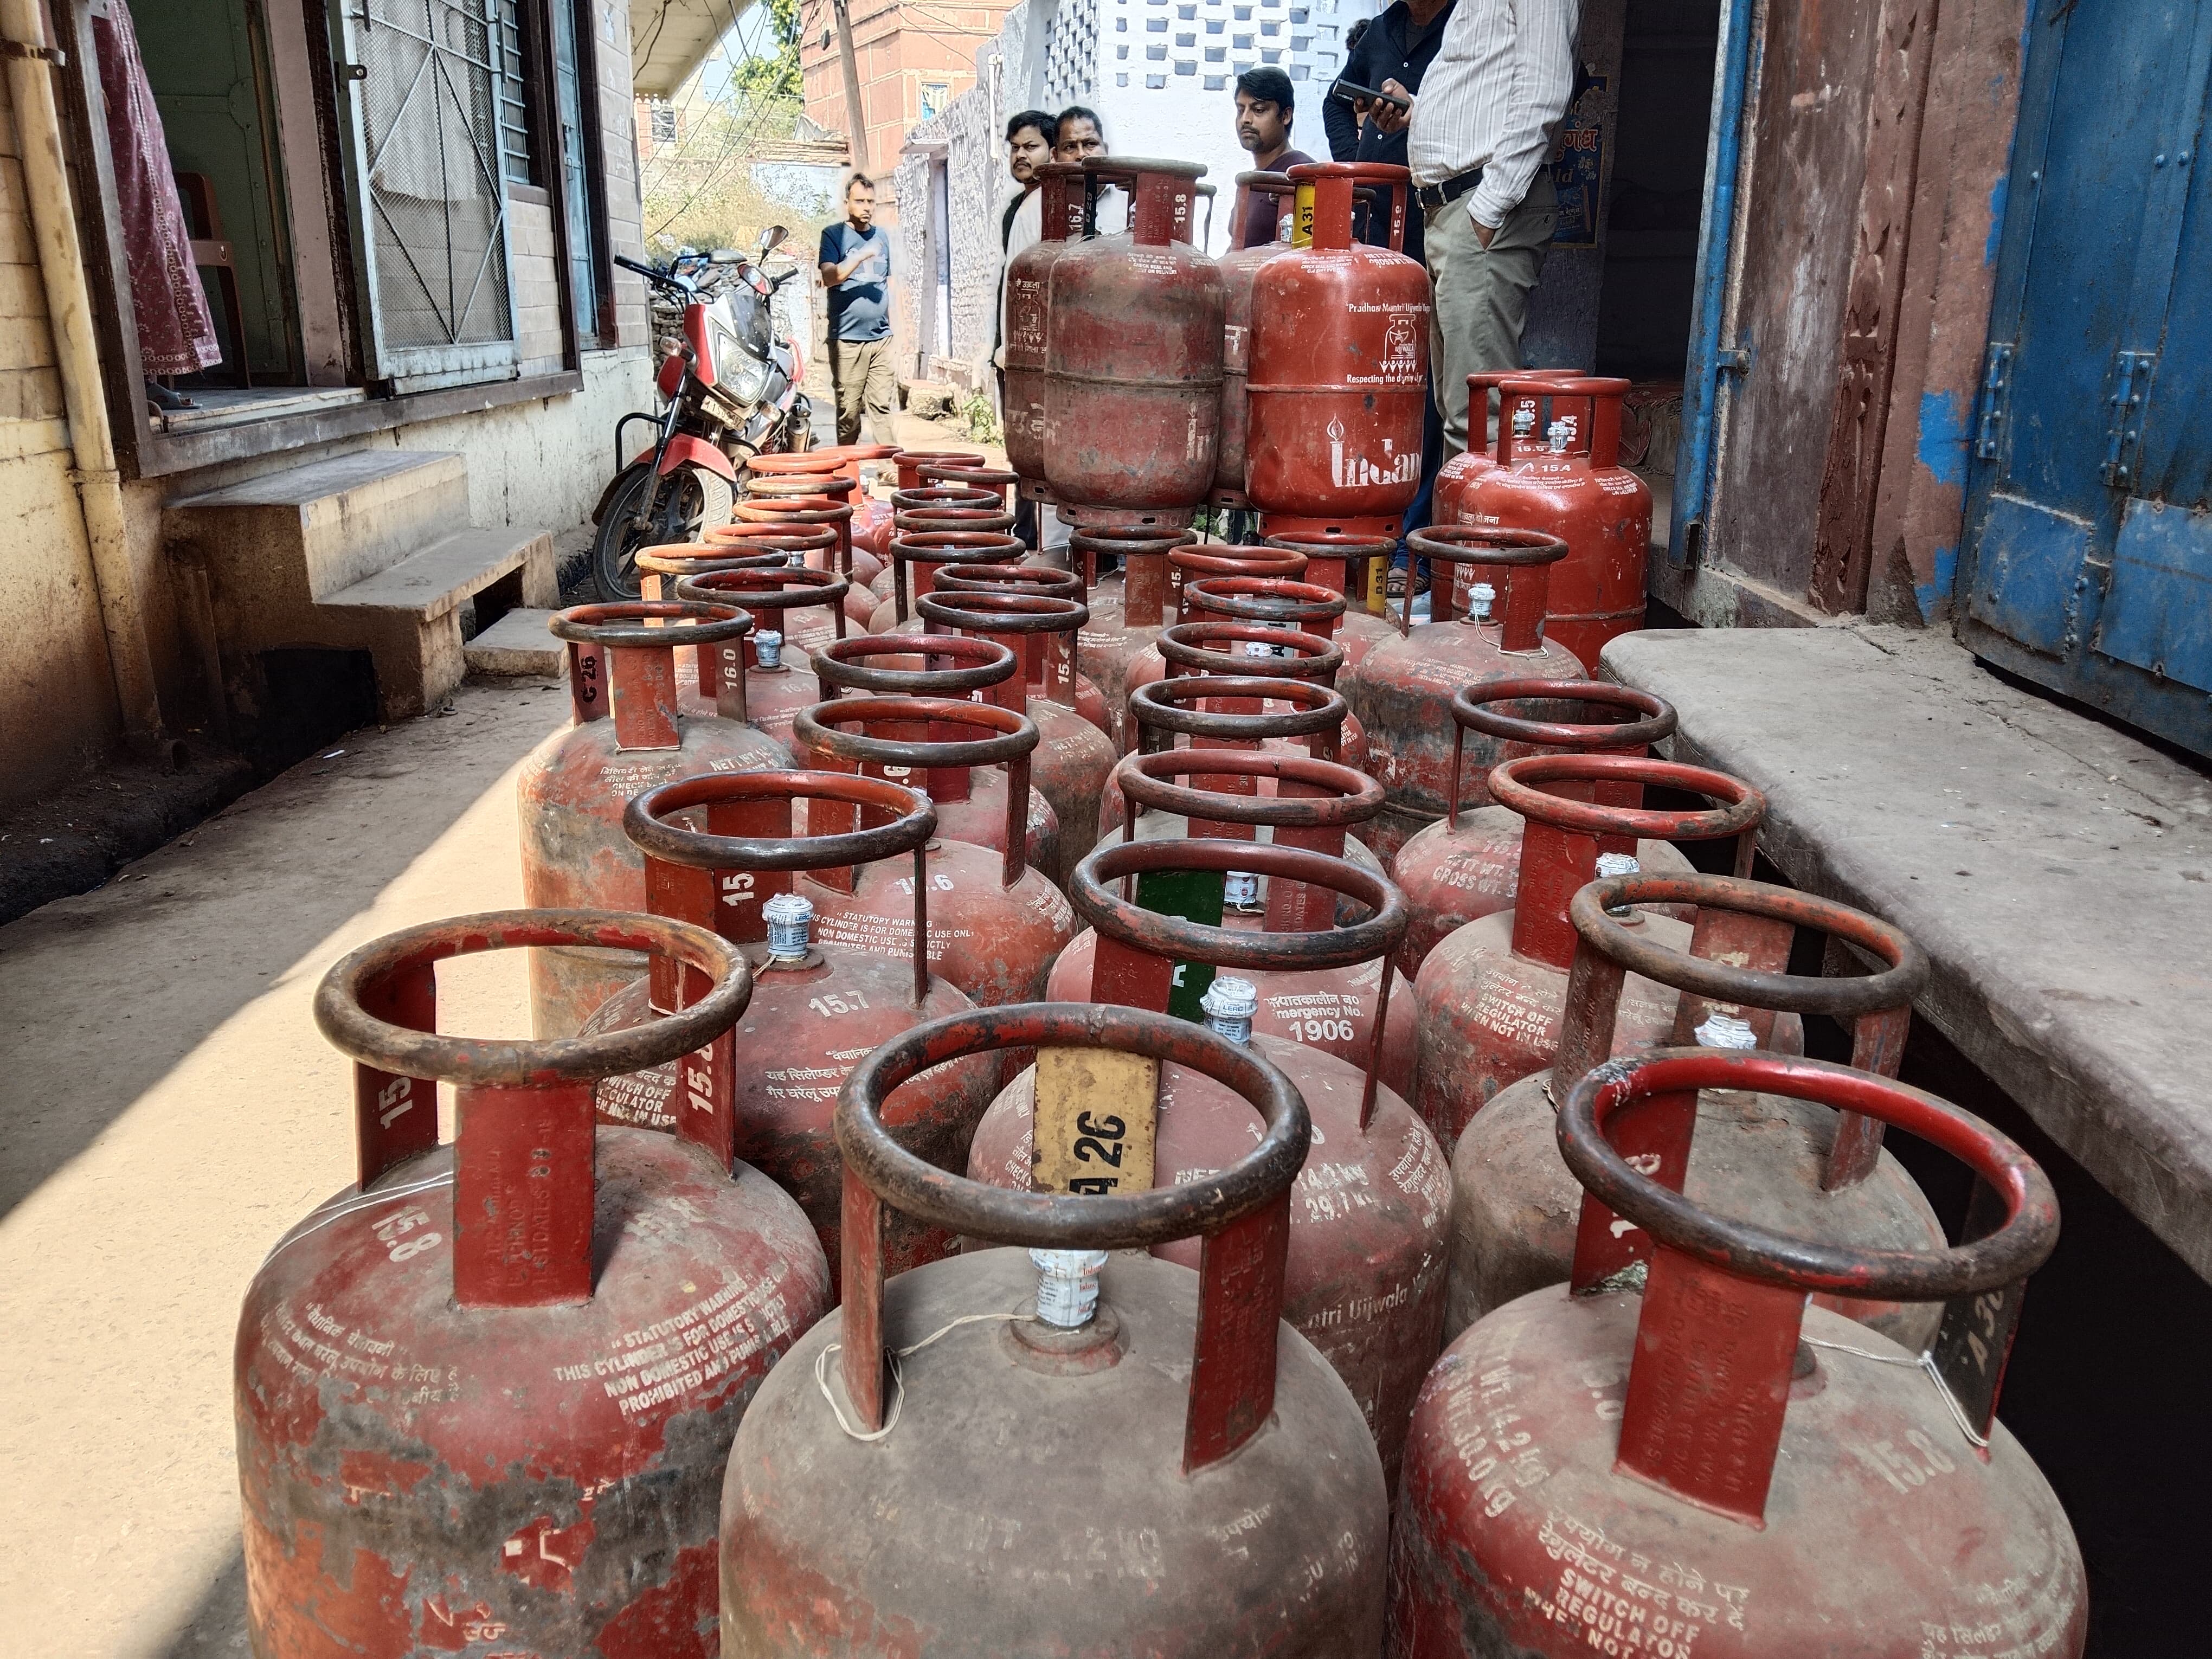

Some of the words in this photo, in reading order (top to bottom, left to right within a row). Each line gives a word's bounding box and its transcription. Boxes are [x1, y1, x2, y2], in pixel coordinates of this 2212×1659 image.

[1174, 194, 1186, 223] 15.8
[1302, 207, 1313, 222] 31
[1302, 226, 1313, 235] A
[1347, 374, 1384, 384] Respecting
[1385, 374, 1396, 382] the
[1375, 568, 1383, 582] 31
[1375, 584, 1383, 595] D
[582, 655, 597, 681] 26
[724, 648, 738, 690] 16.0
[582, 686, 597, 703] C
[781, 683, 813, 693] 16.1
[1433, 866, 1476, 890] GROSS
[821, 916, 858, 930] CYLINDER
[870, 925, 886, 935] FOR
[935, 930, 951, 938] USE
[843, 912, 890, 926] STATUTORY
[892, 919, 933, 927] WARNG
[818, 927, 834, 938] NON
[837, 931, 878, 944] DOMESTIC
[880, 937, 896, 946] USE
[808, 989, 870, 1018] 15.7
[1271, 1006, 1340, 1019] mergency
[1343, 1006, 1364, 1017] No.
[1482, 993, 1526, 1018] SWITCH
[1527, 1012, 1553, 1026] OFF
[1289, 1019, 1354, 1042] 1906
[1475, 1001, 1546, 1036] REGULATOR
[1489, 1020, 1515, 1037] NOT
[765, 1070, 786, 1081] यह
[596, 1096, 608, 1111] EN
[645, 1086, 672, 1099] OFF
[766, 1085, 786, 1099] गैर
[786, 1084, 823, 1103] घरेलू
[1073, 1110, 1126, 1169] 26
[1005, 1160, 1030, 1185] CHECK
[371, 1205, 443, 1263] 15.8
[622, 1307, 700, 1348] STATUTORY
[698, 1278, 748, 1315] WARNING
[1307, 1304, 1342, 1328] ntri
[1348, 1284, 1409, 1321] Ujjwala
[553, 1362, 592, 1382] THIS
[594, 1343, 668, 1376] CYLINDER
[683, 1326, 709, 1348] FOR
[603, 1374, 639, 1398] NON
[639, 1344, 709, 1387] DOMESTIC
[710, 1335, 731, 1354] USE
[618, 1371, 703, 1416] PROHIBITED
[1848, 1428, 1957, 1495] 15.8
[1538, 1517, 1617, 1584] रेगुलेटर
[1630, 1553, 1651, 1573] न
[1560, 1568, 1647, 1623] SWITCH
[1652, 1616, 1701, 1643] OFF
[1555, 1586, 1691, 1659] REGULATOR
